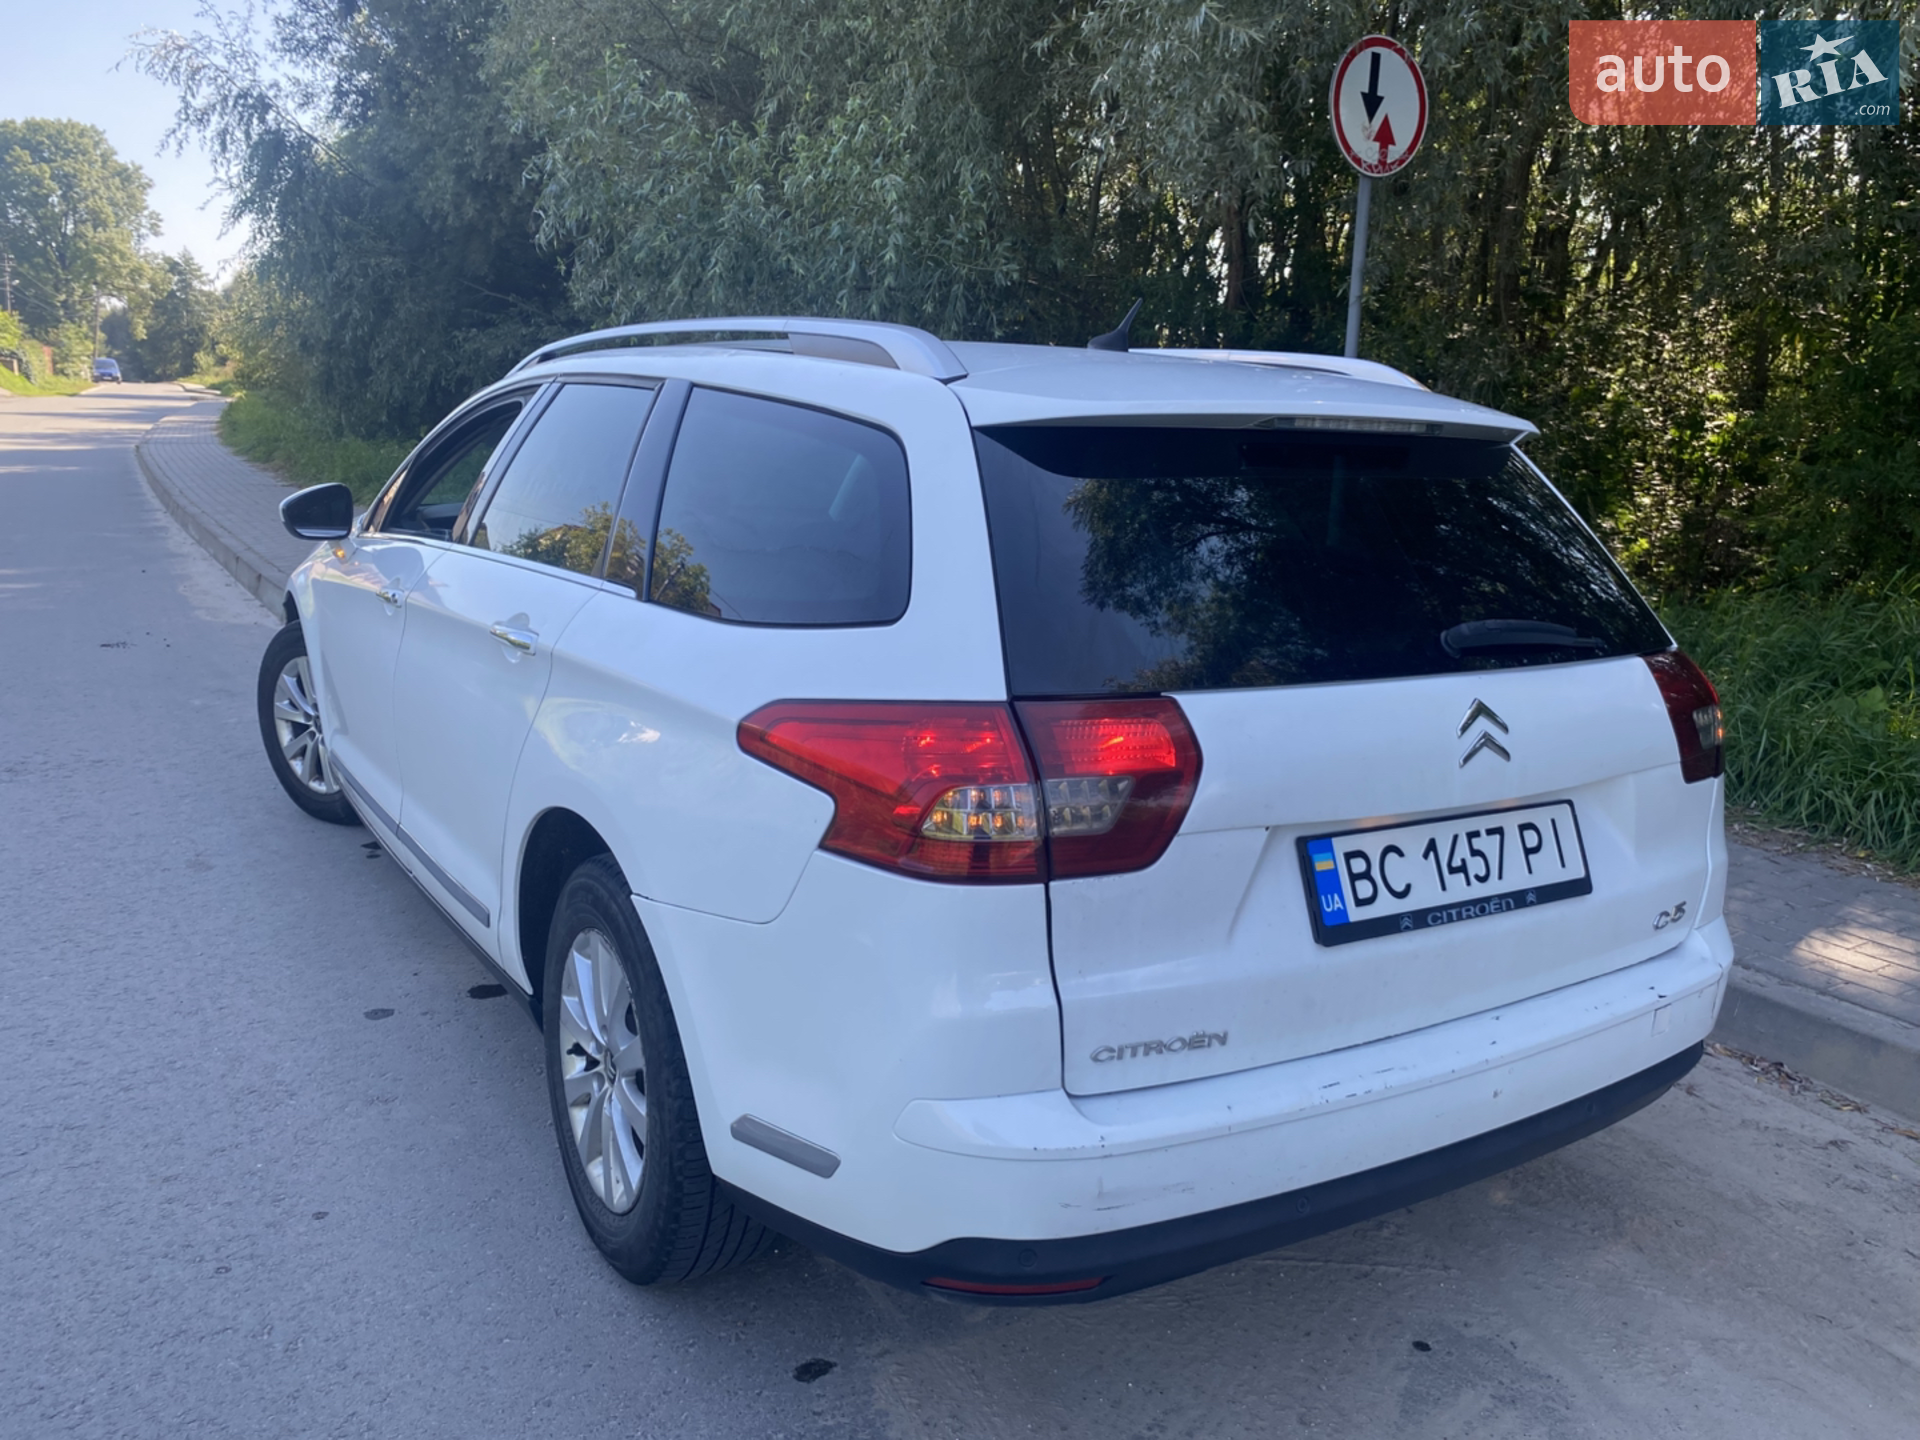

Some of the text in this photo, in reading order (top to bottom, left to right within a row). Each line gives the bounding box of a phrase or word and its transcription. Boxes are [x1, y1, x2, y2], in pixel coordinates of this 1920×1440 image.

[1343, 818, 1566, 908] BC 1457 PI
[1321, 893, 1344, 912] UA
[1652, 900, 1687, 931] C5
[1089, 1030, 1229, 1063] CITROËN
